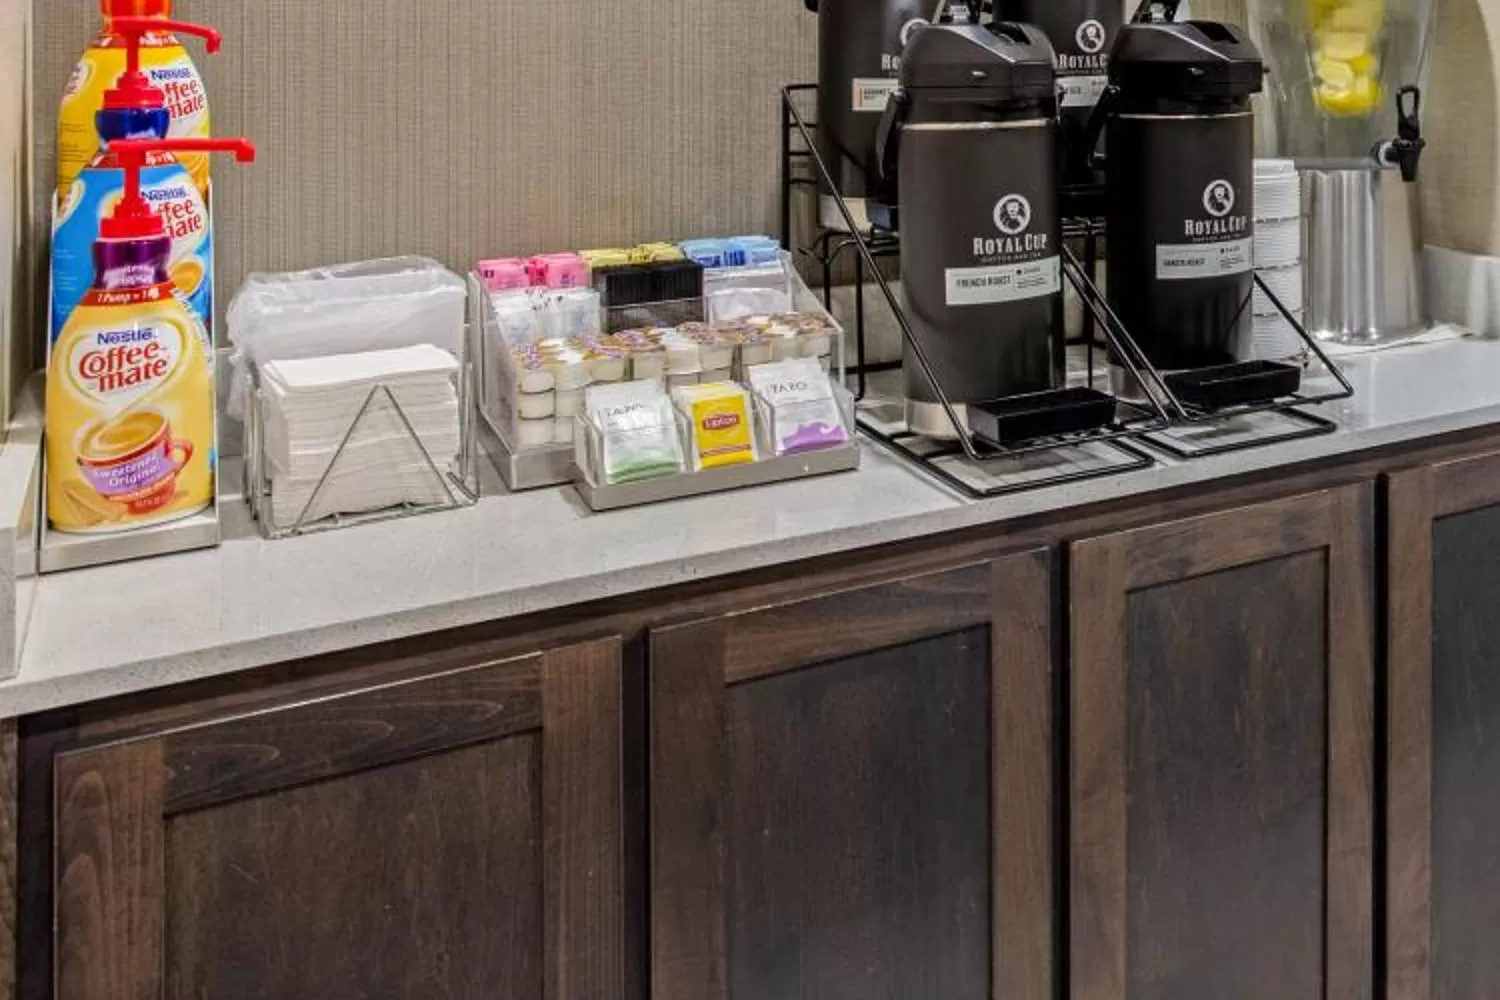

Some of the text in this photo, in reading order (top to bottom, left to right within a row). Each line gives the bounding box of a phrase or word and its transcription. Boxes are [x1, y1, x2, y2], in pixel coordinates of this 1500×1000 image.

[1059, 53, 1099, 69] ROYAL
[1184, 219, 1227, 236] ROYAL
[973, 233, 1048, 255] ROYAL CUP
[99, 359, 168, 393] mate
[705, 415, 737, 430] Lipton
[108, 460, 161, 487] Original
